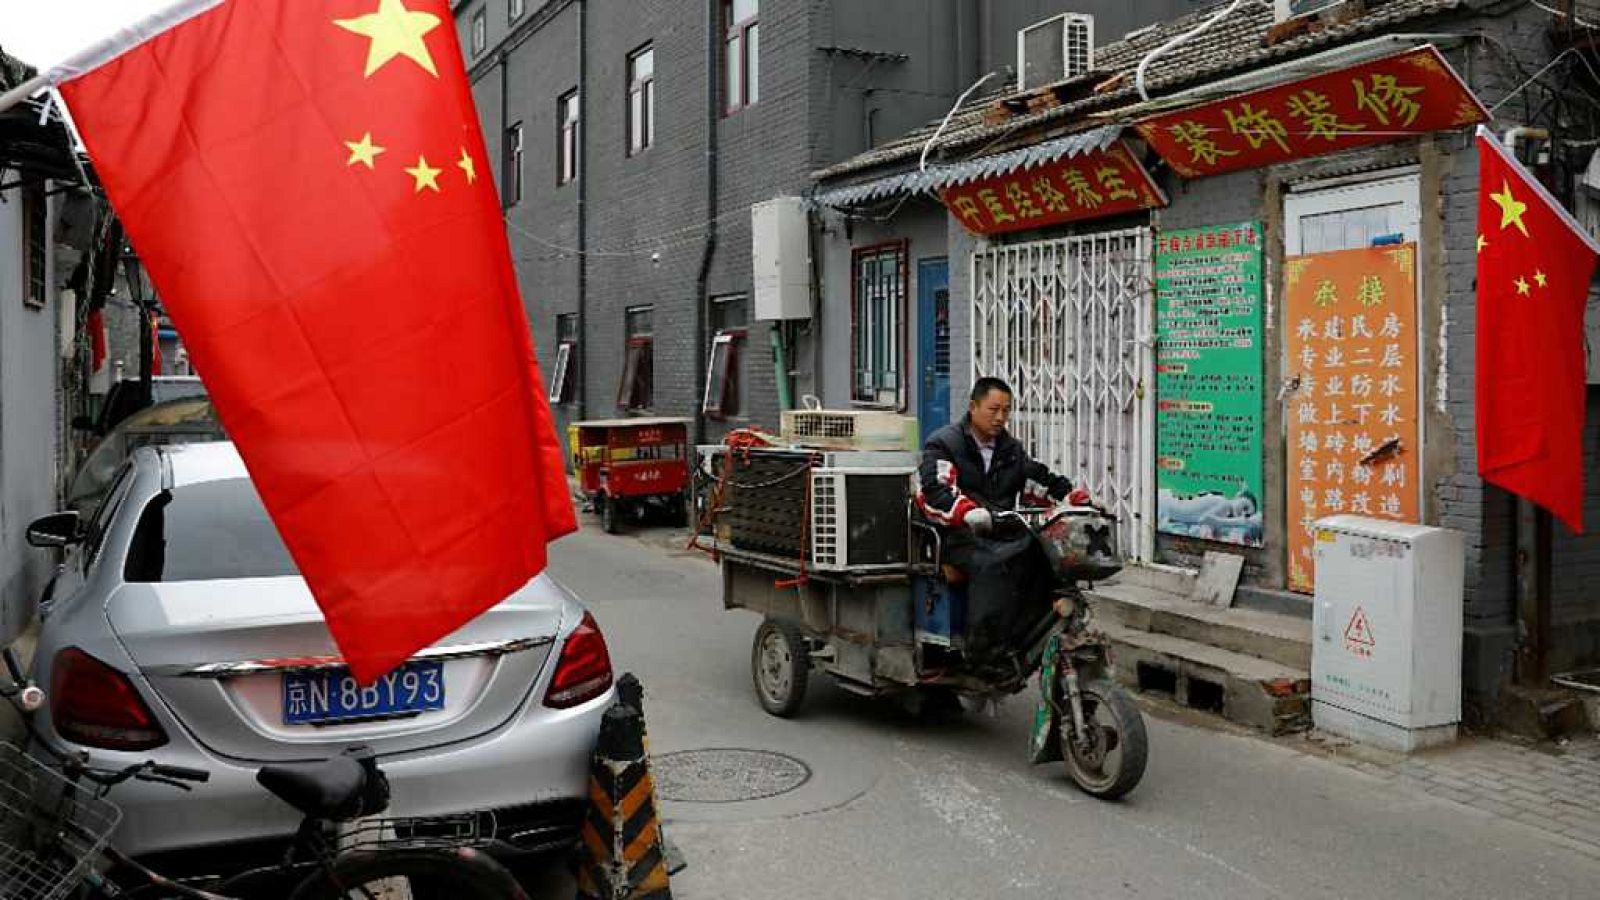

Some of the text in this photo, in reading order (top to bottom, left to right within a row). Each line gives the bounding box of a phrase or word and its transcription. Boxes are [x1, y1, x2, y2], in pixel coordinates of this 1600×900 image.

[1168, 74, 1426, 165] 装饰装修
[953, 167, 1138, 229] 中医经络养生
[1314, 275, 1386, 307] 承接
[1296, 311, 1405, 342] 承建民房
[1298, 344, 1405, 370] 专业二层
[1299, 372, 1405, 398] 专业防水
[1298, 400, 1406, 426] 做上下水
[1299, 455, 1405, 488] 室内粉刷
[1299, 485, 1405, 518] 电路改造
